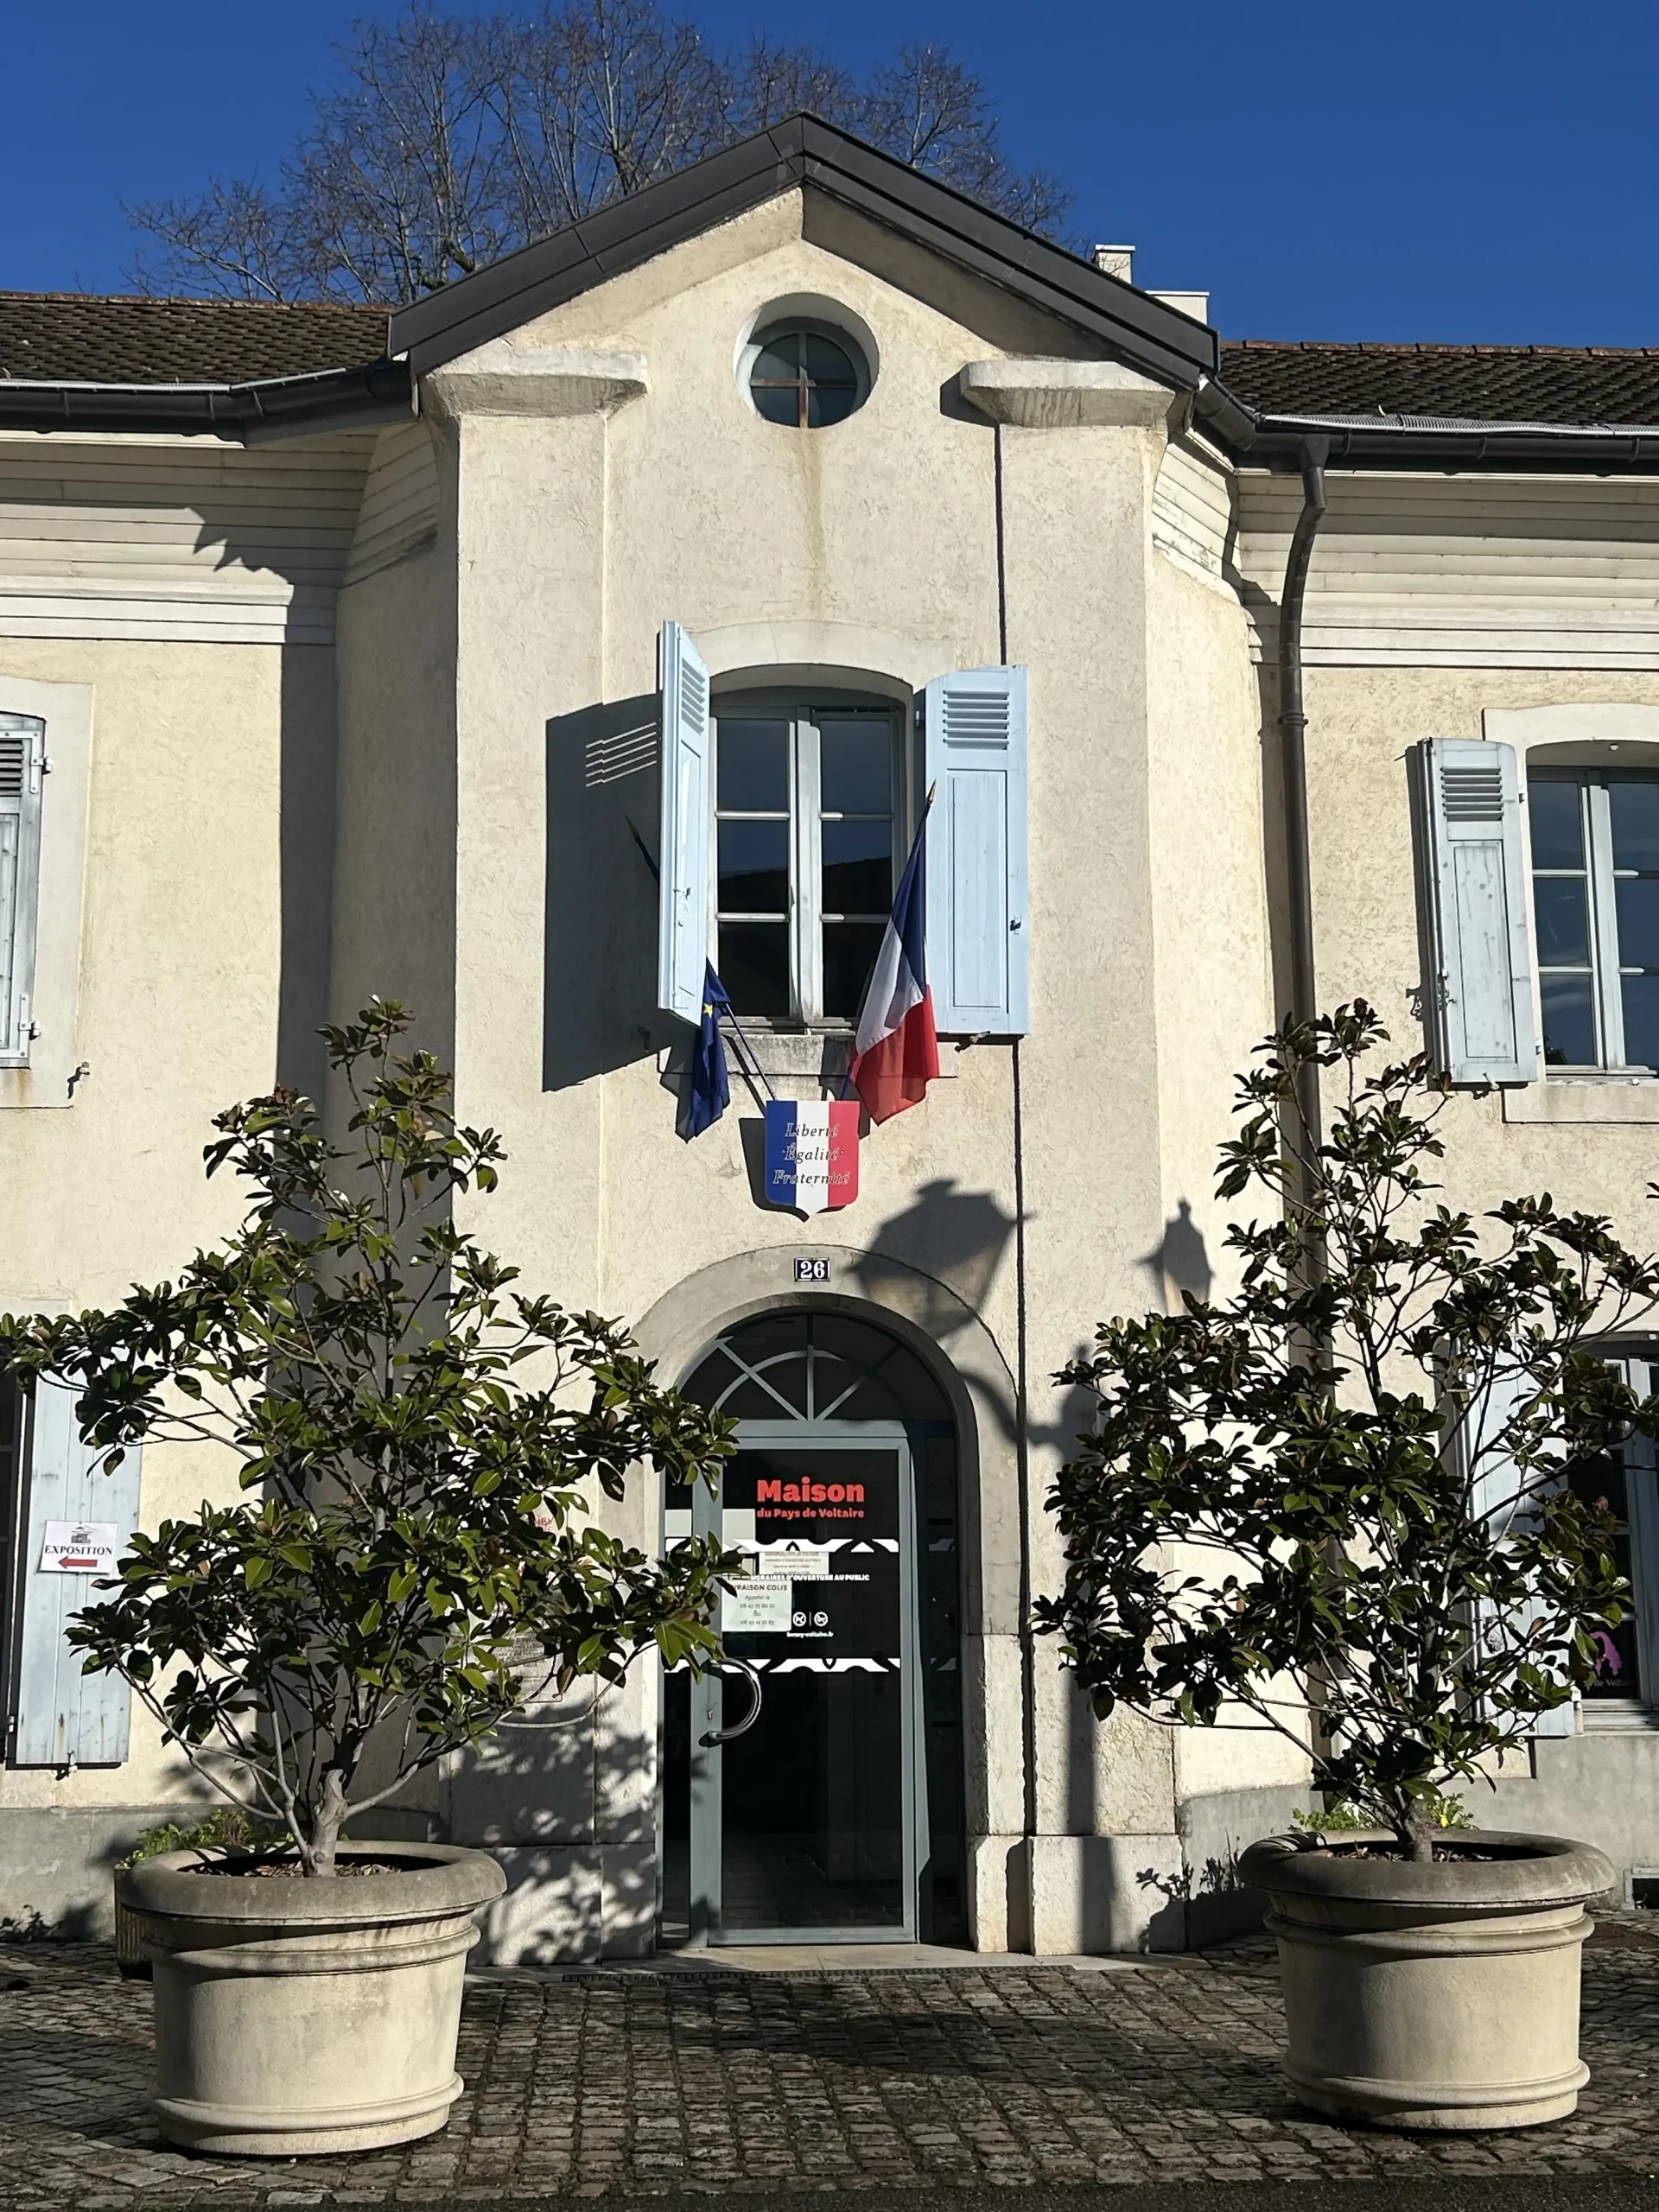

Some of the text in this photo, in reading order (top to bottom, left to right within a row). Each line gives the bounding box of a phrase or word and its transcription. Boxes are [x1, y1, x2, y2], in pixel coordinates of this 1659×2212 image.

[785, 1122, 839, 1137] Liberté
[772, 1169, 850, 1185] Fraternité
[800, 1261, 825, 1279] 26
[757, 1476, 865, 1503] Maison
[757, 1507, 865, 1520] du Pays de Voltaire
[44, 1545, 113, 1555] EXPOSITION
